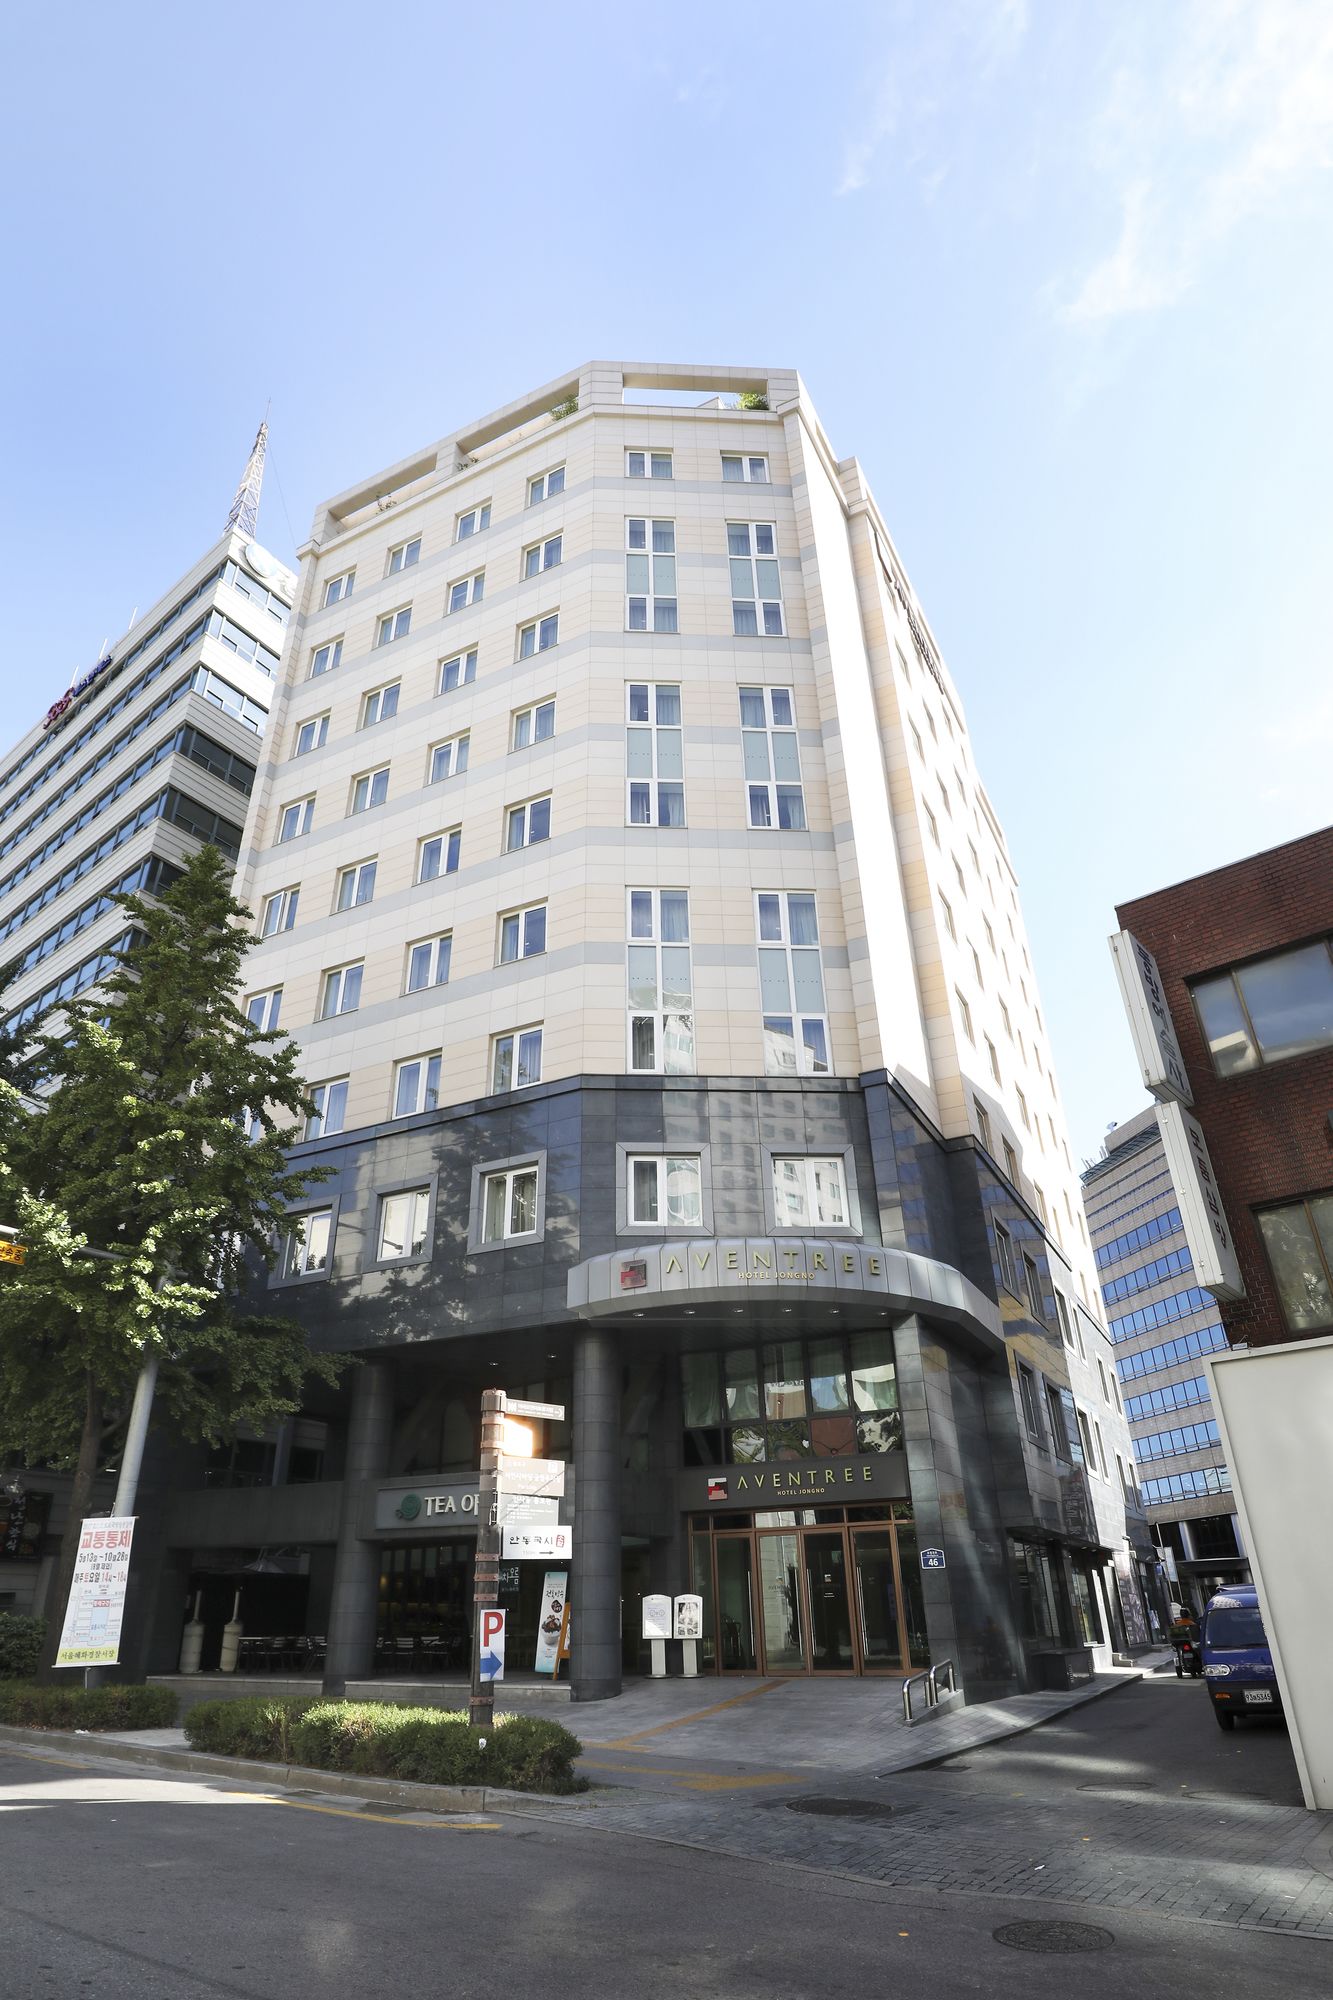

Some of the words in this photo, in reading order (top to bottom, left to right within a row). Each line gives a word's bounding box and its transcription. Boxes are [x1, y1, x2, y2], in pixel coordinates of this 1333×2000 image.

[666, 1251, 881, 1276] AVENTREE
[738, 1271, 770, 1279] HOTEL
[775, 1271, 815, 1280] JONGNO
[737, 1466, 872, 1490] AVENTREE
[799, 1487, 825, 1495] JONGNO
[424, 1495, 456, 1516] TEA
[81, 1530, 131, 1549] 교통통제
[928, 1558, 939, 1567] 46
[483, 1611, 504, 1648] P
